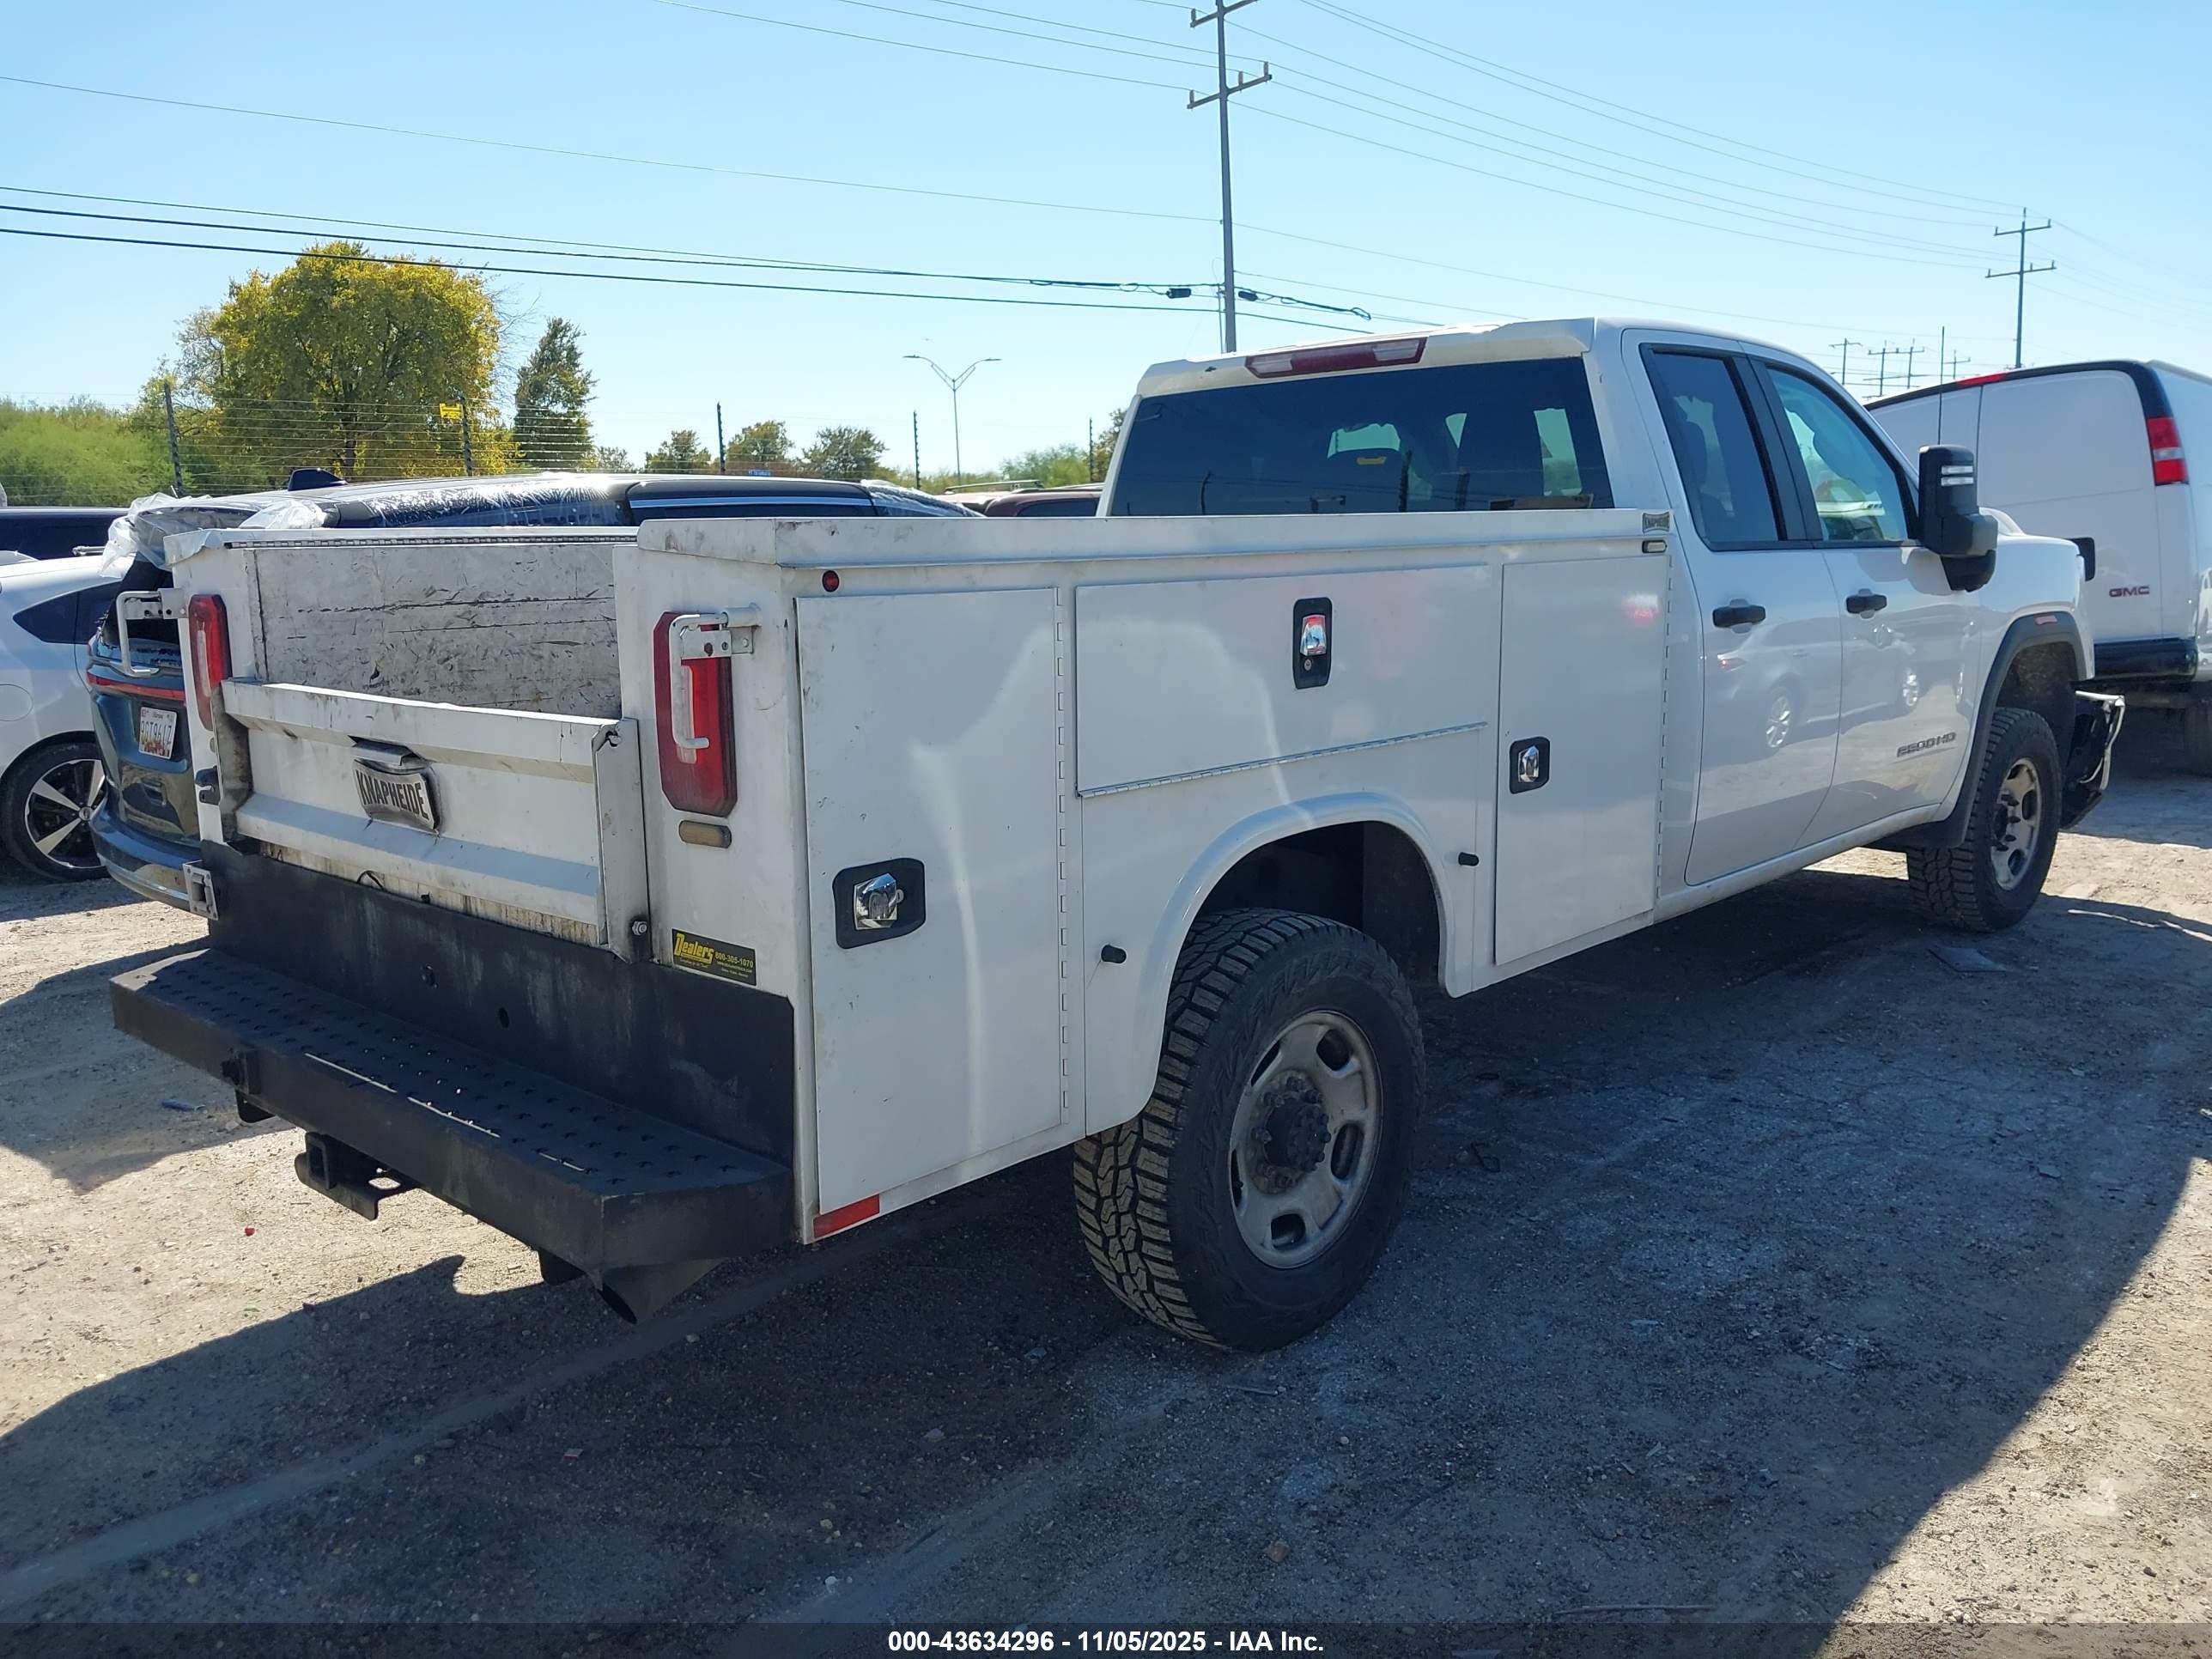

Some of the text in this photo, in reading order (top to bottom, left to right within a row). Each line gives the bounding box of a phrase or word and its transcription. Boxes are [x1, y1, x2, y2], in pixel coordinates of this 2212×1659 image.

[2109, 586, 2151, 598] GMC
[356, 769, 429, 820] KNAPHEIDE
[674, 933, 714, 963] Dealers
[714, 951, 754, 969] 800-305-1070
